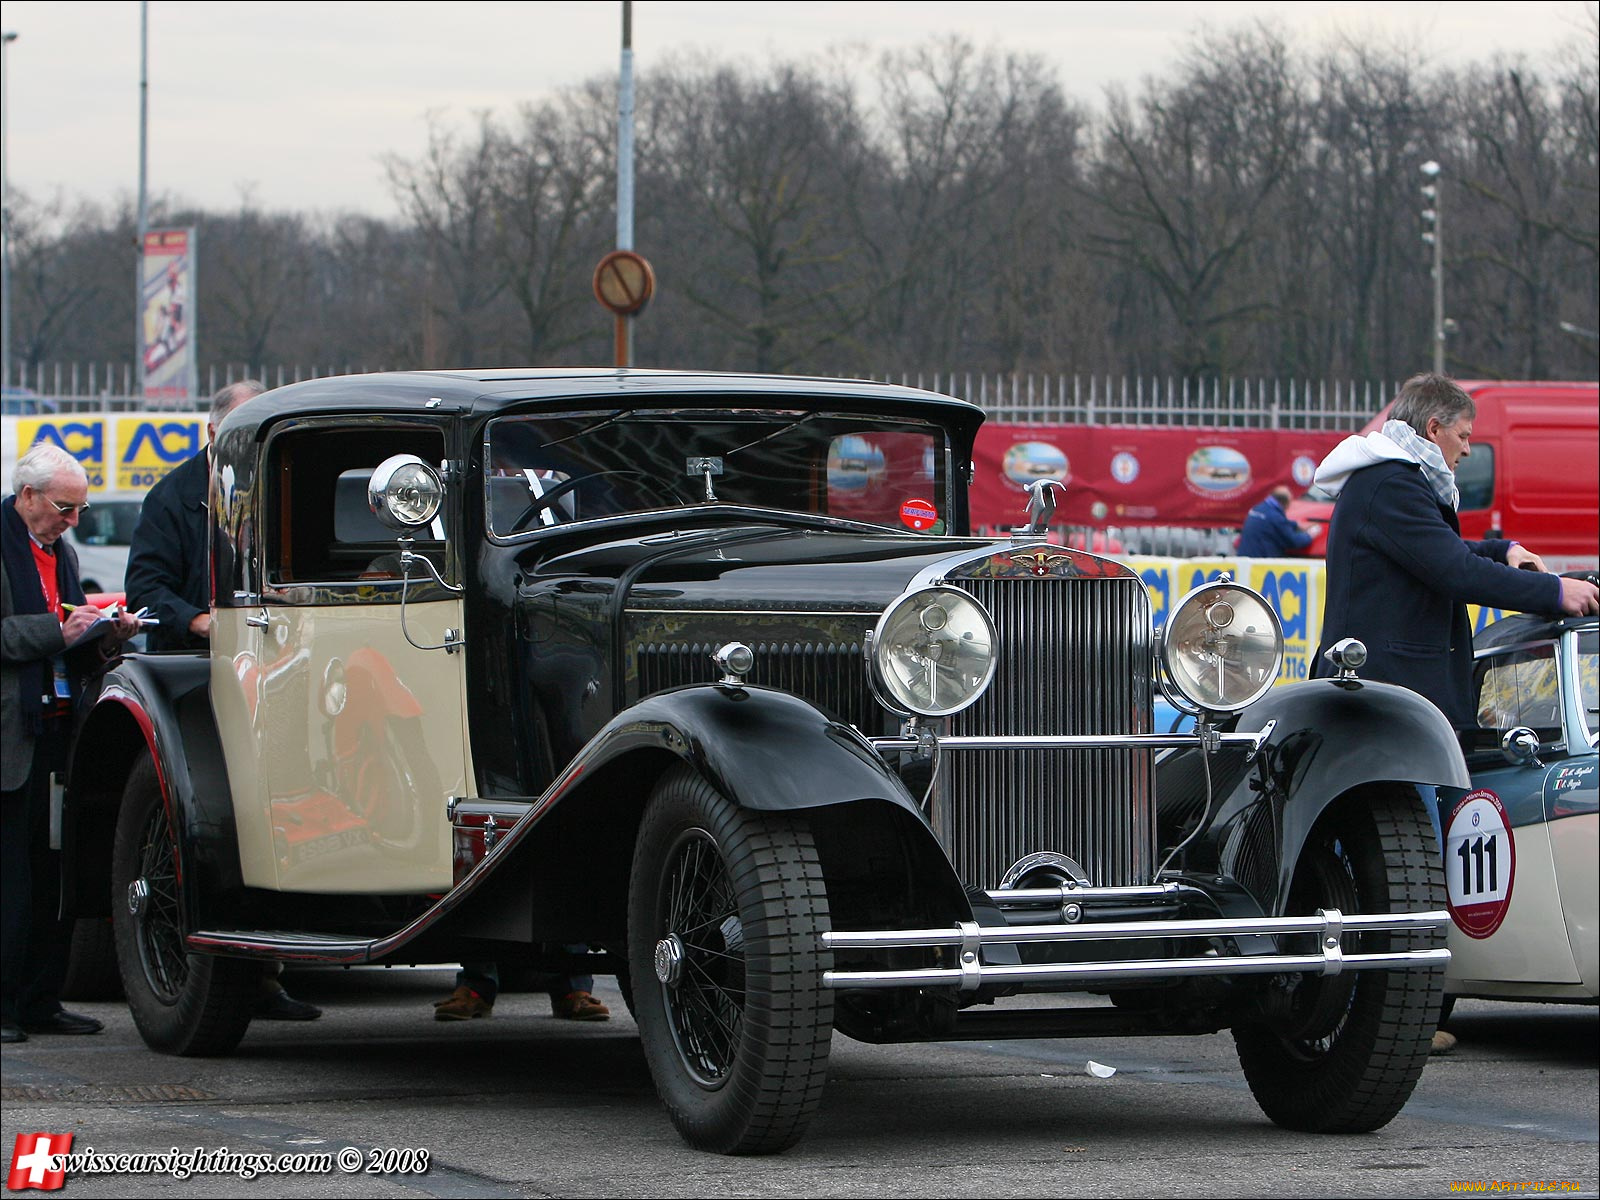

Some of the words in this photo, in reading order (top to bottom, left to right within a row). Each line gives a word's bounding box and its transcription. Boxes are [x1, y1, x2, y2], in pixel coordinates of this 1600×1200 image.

[31, 421, 103, 463] ACI
[123, 422, 199, 463] ACI
[1142, 568, 1169, 630] CI
[1260, 570, 1307, 641] ACI
[1457, 835, 1497, 896] 111
